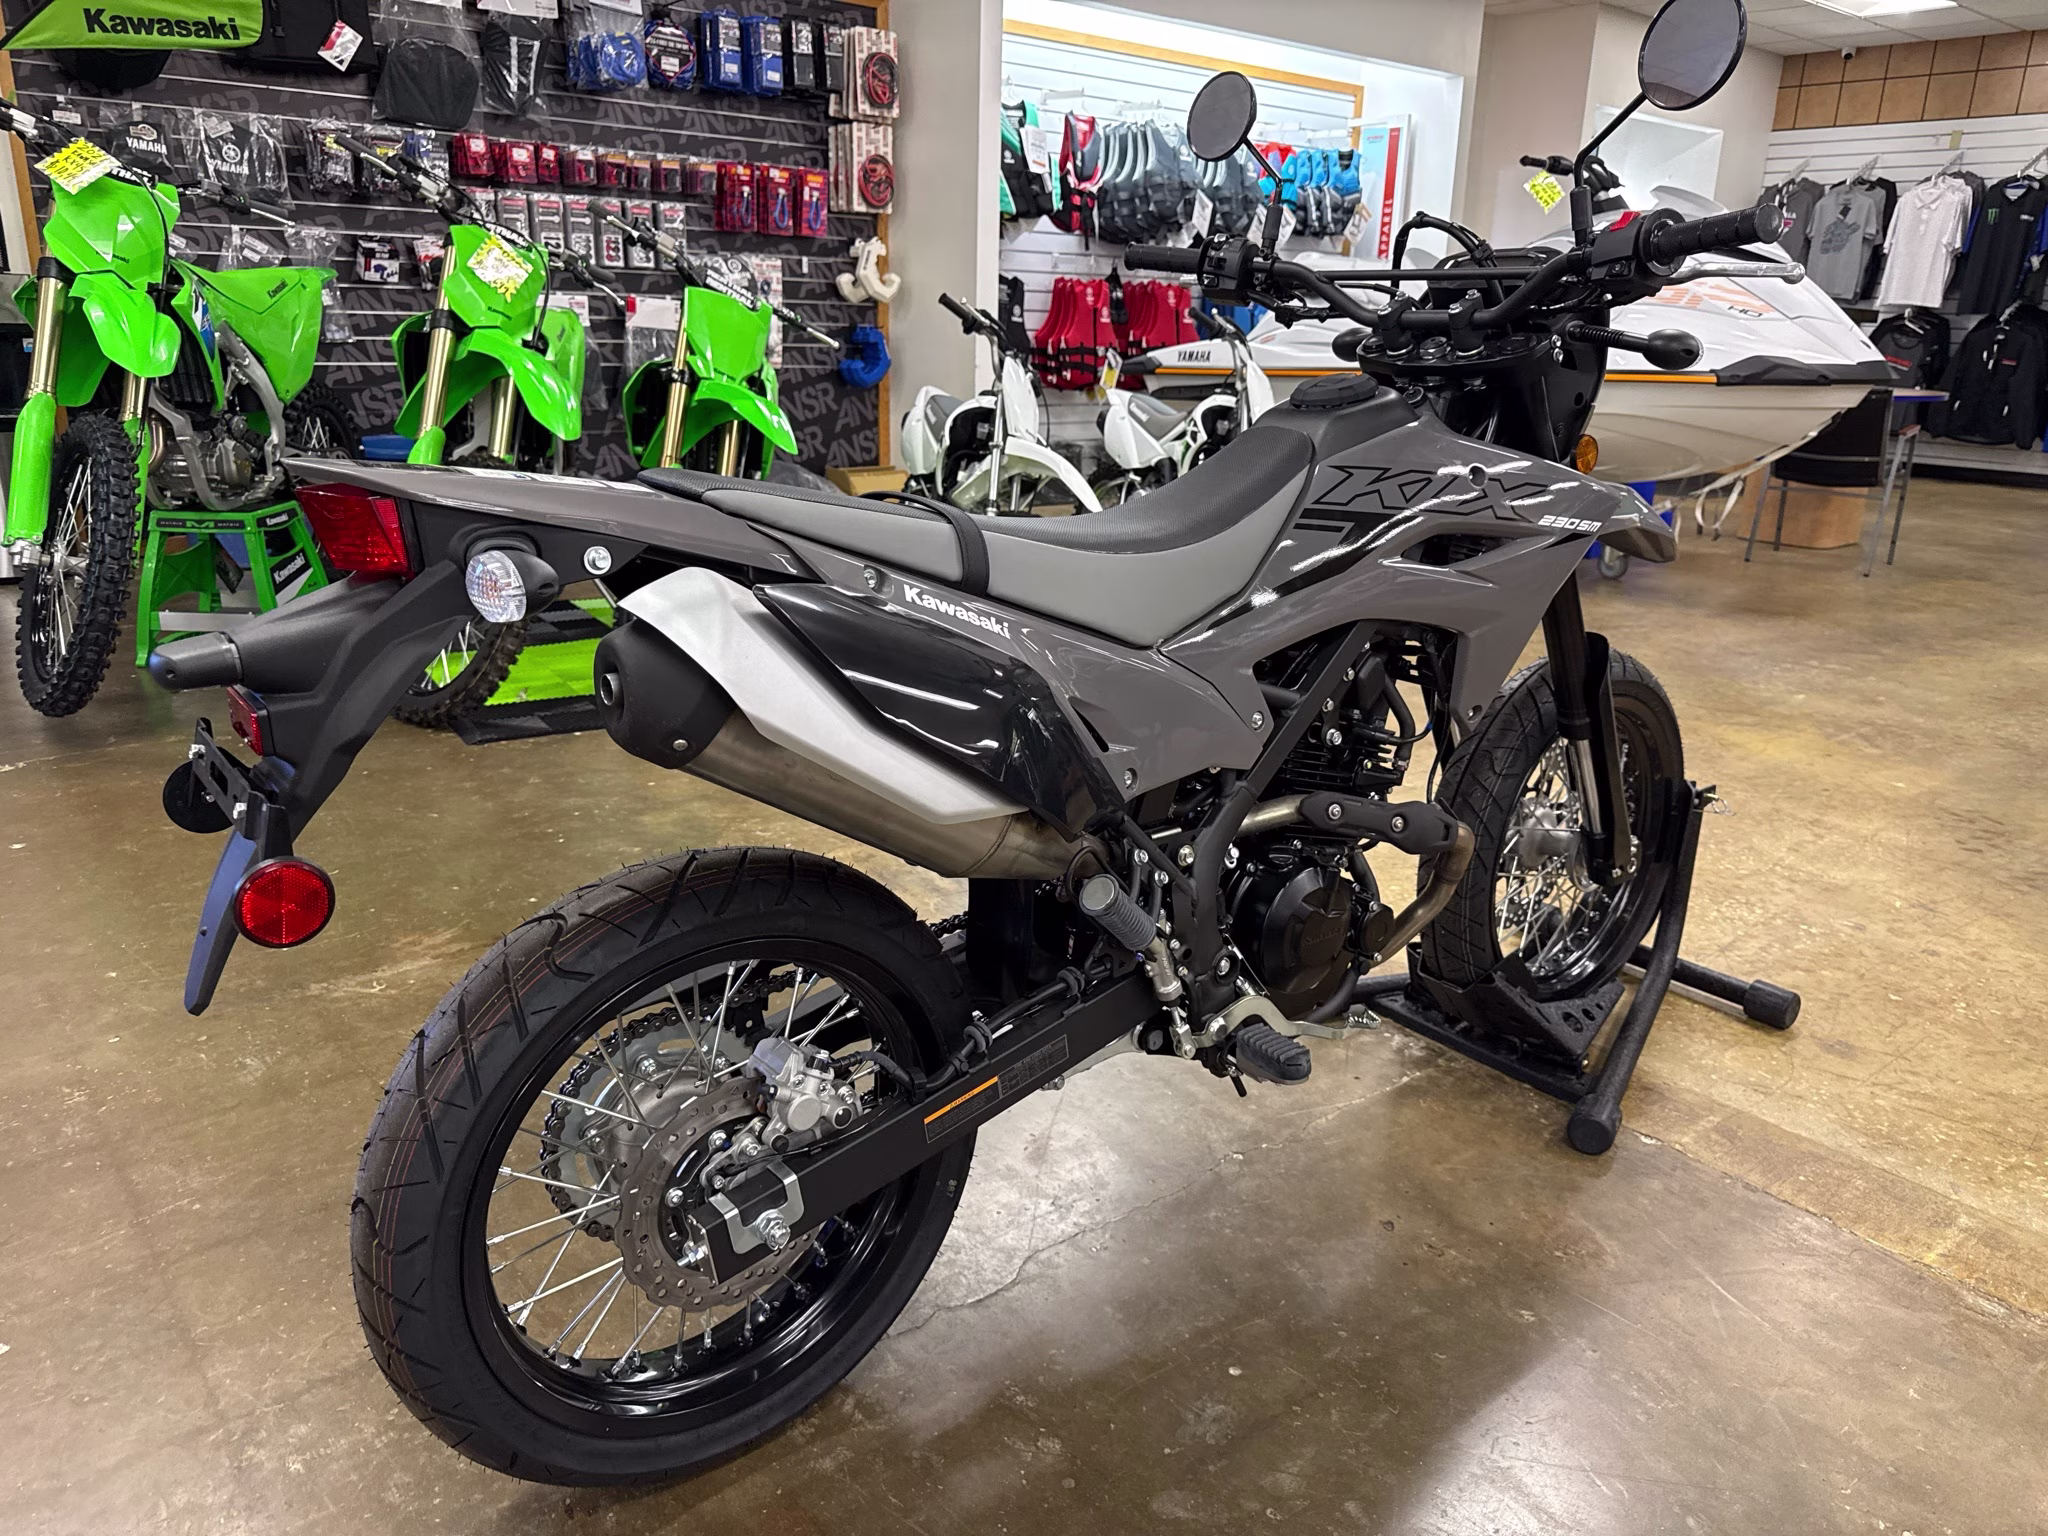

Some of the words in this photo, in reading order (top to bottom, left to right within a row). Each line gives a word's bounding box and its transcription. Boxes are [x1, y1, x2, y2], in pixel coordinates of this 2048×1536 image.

[83, 8, 240, 40] Kawasaki
[126, 137, 167, 155] YAMAHA
[209, 158, 250, 175] YAMAHA
[1379, 199, 1393, 260] APPAREL
[1177, 350, 1212, 363] YAMAHA
[1313, 465, 1548, 524] KLX
[1538, 513, 1602, 533] 230SM
[273, 553, 306, 585] Kawasaki
[903, 584, 1011, 640] Kawasaki
